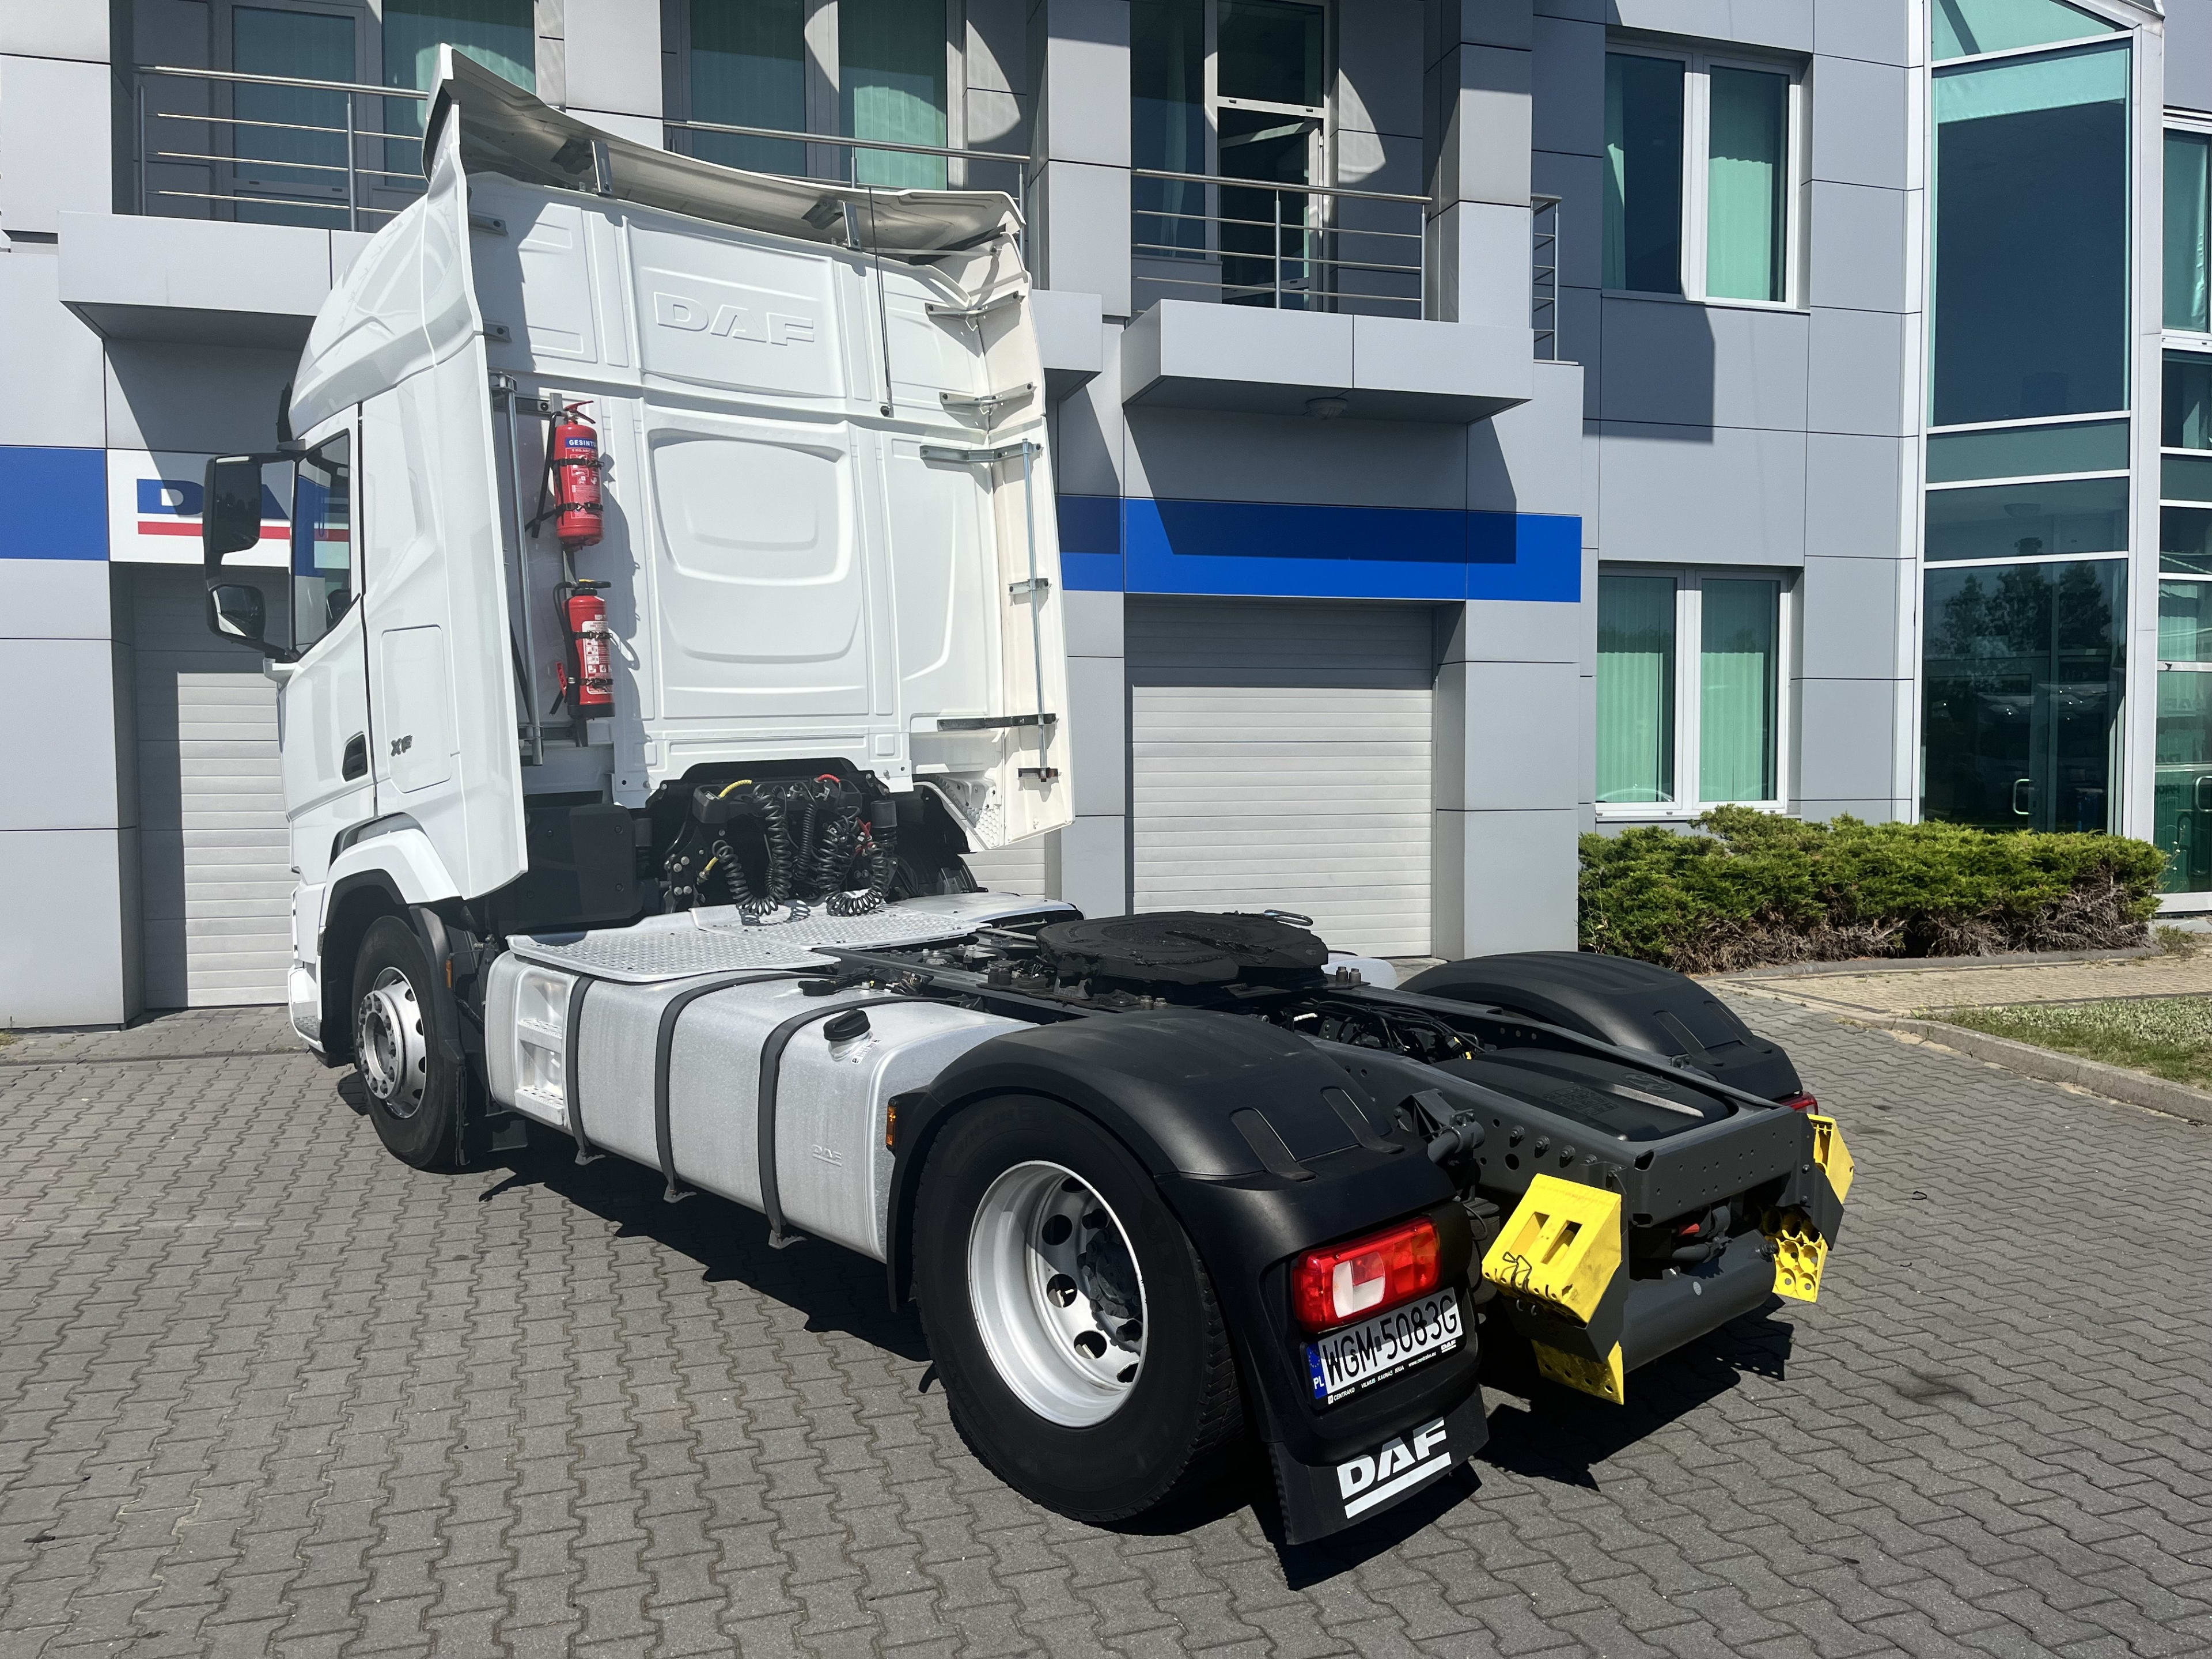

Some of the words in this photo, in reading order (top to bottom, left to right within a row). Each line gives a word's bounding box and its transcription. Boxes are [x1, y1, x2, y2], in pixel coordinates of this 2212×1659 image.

[654, 291, 814, 346] DAF
[812, 1144, 842, 1160] DAF
[1322, 1326, 1377, 1387] WGM
[1380, 1295, 1457, 1359] 5083G
[1334, 1387, 1355, 1401] CENTRAKO
[1377, 1370, 1393, 1381] KAUNAS
[1441, 1339, 1456, 1350] DAF
[1313, 1377, 1324, 1389] PL
[1336, 1417, 1446, 1499] DAF
